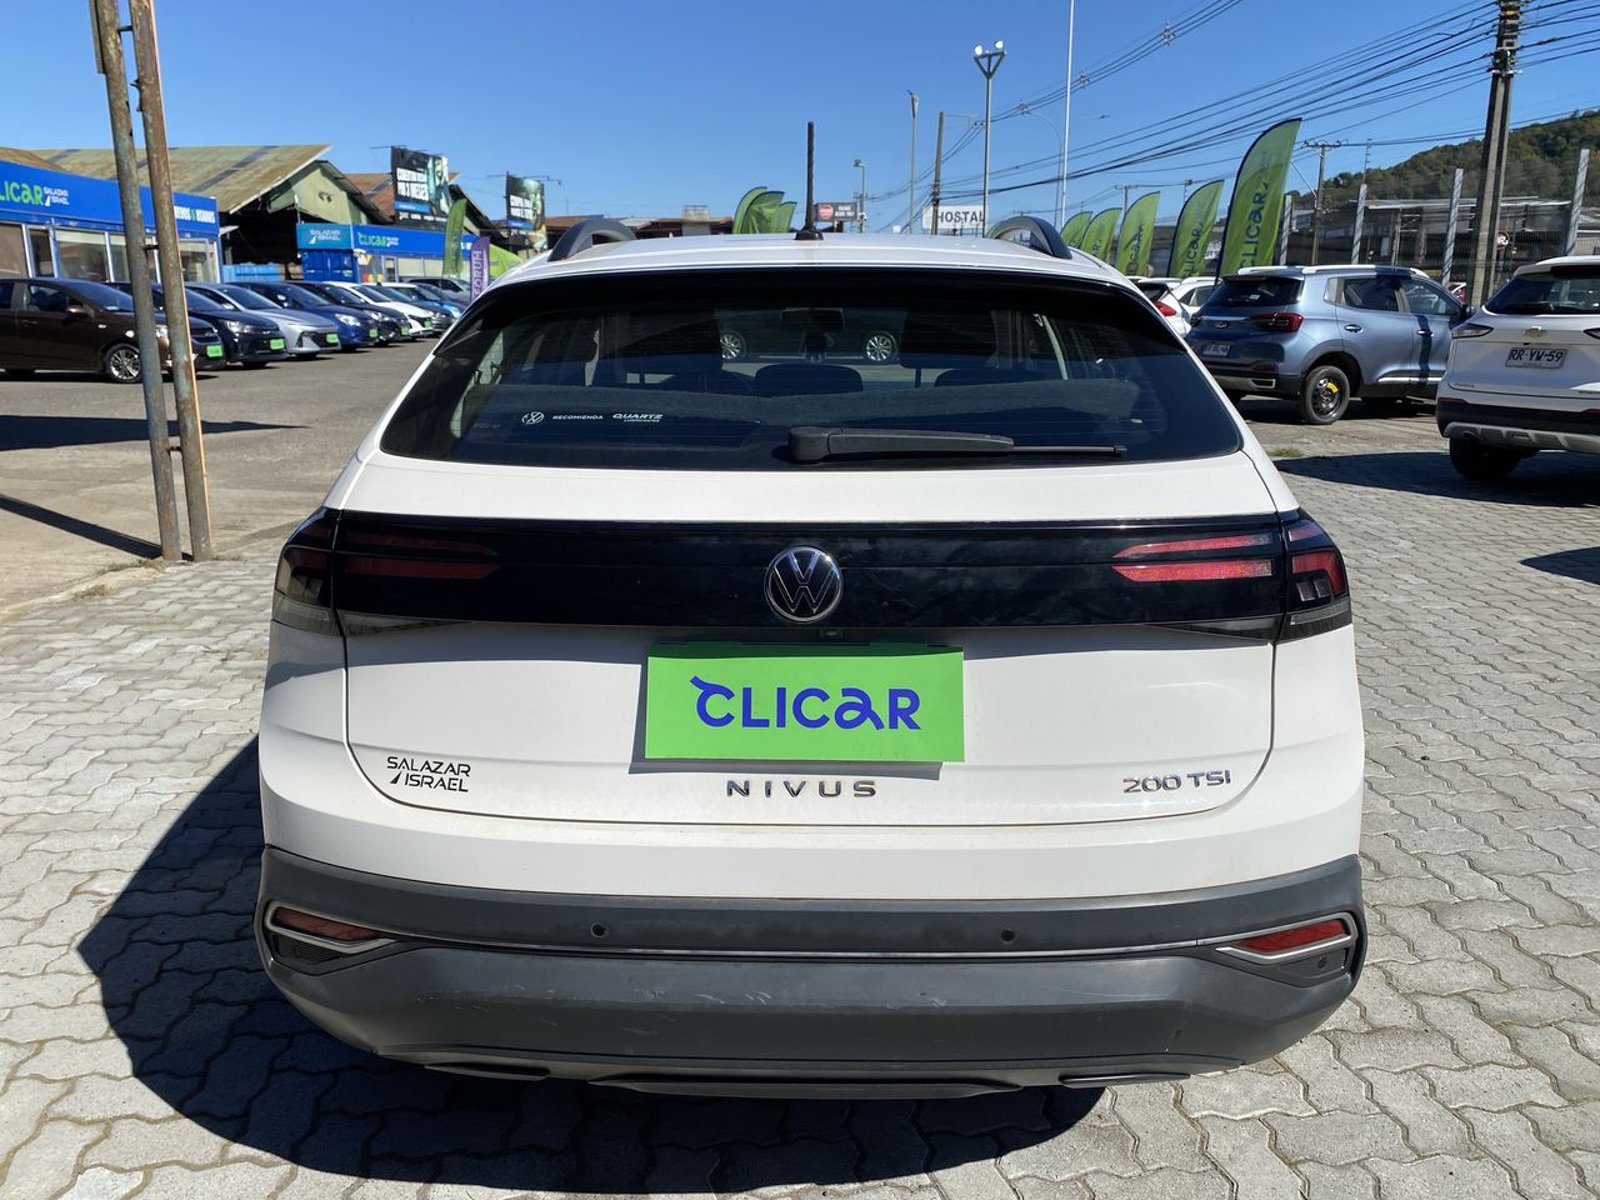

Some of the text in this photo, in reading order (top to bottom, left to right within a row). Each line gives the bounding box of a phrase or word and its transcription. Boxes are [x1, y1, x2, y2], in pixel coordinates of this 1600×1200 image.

[937, 210, 984, 223] HOSTAL
[386, 756, 471, 777] SALAZAR
[404, 772, 469, 793] ISRAEL
[726, 779, 877, 798] NIVUS
[1123, 769, 1232, 793] 200 TSI
